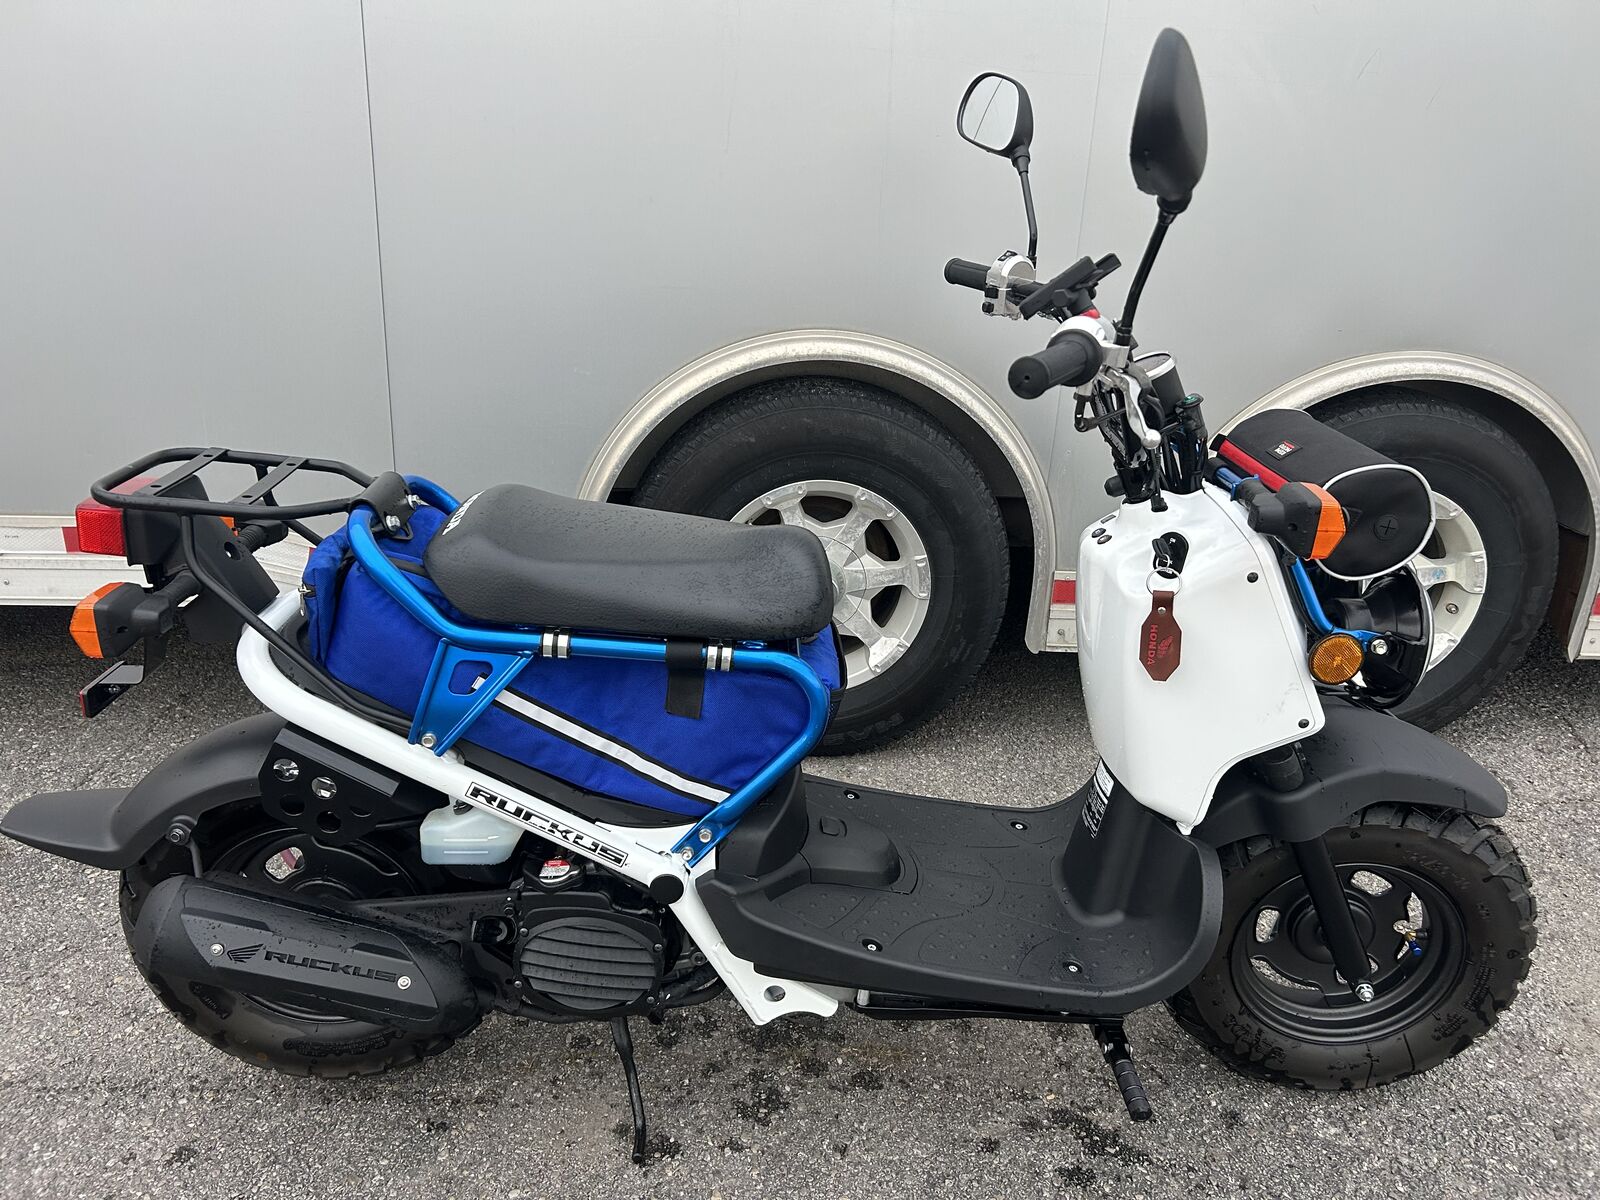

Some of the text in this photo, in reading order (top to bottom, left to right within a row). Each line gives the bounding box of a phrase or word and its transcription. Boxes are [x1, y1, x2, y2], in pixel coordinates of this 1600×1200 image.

[1147, 624, 1158, 665] HONDA
[470, 786, 624, 865] RUCKUS
[264, 950, 397, 983] RUCKUS
